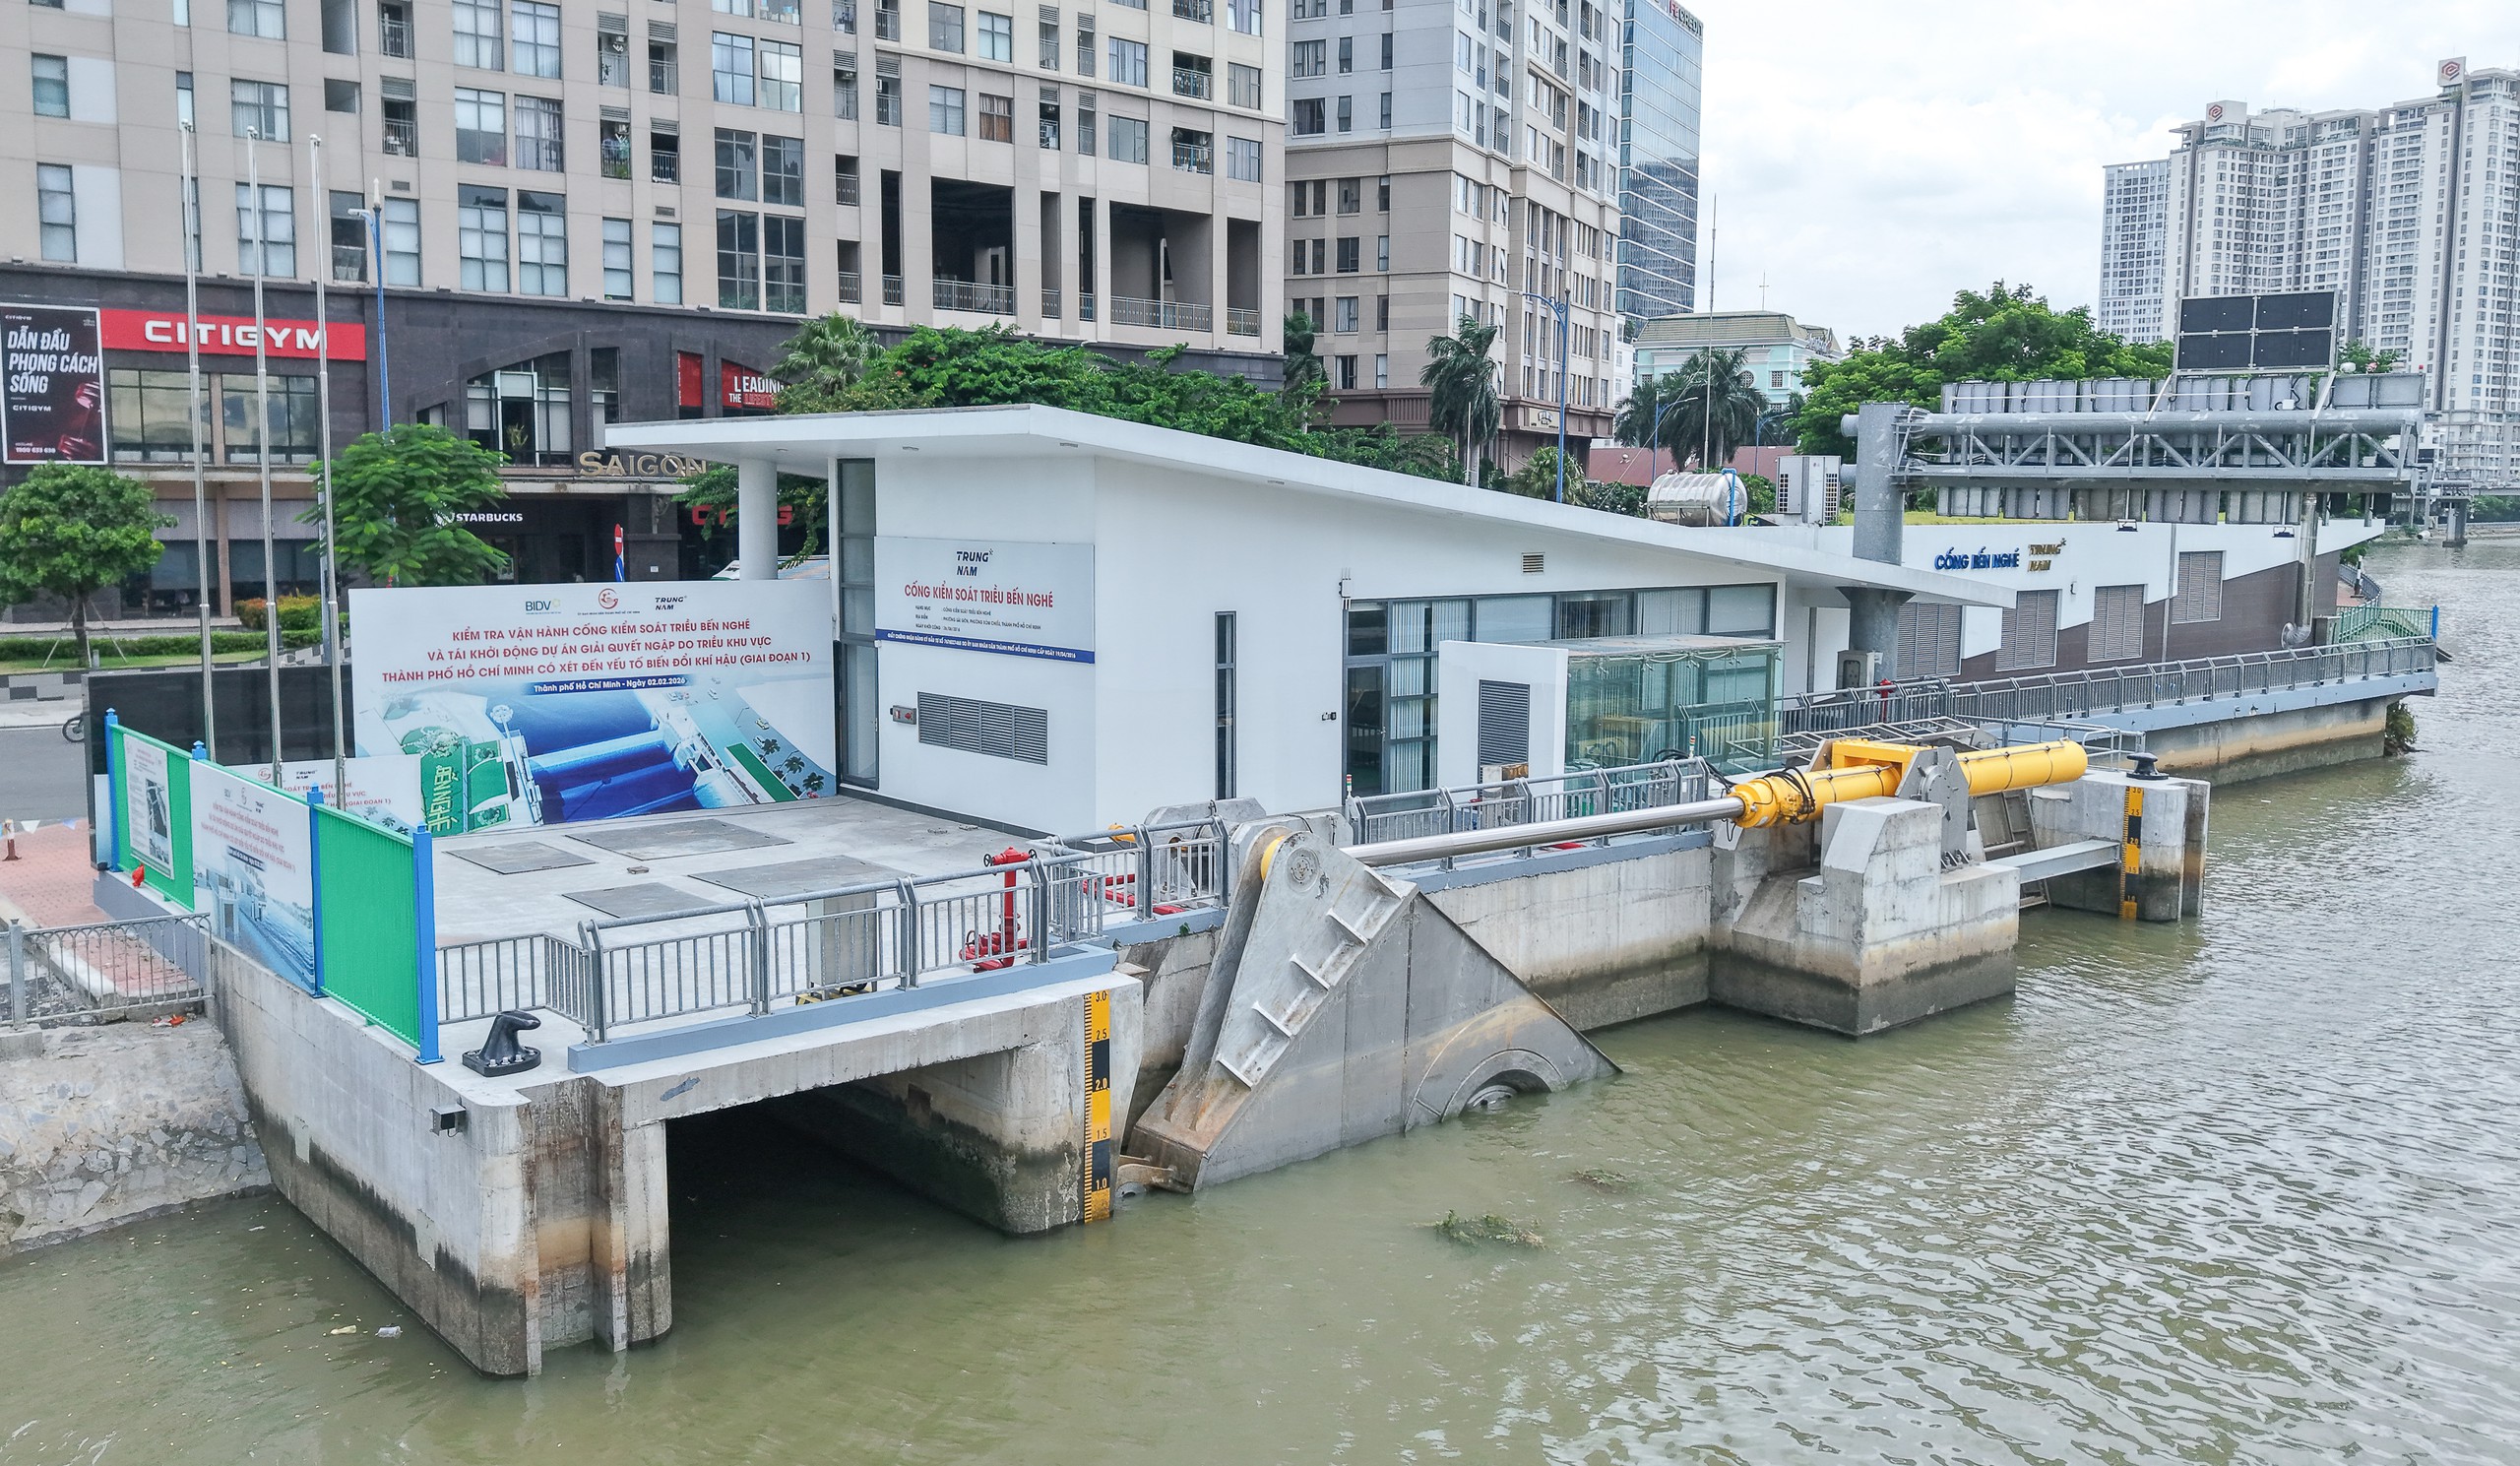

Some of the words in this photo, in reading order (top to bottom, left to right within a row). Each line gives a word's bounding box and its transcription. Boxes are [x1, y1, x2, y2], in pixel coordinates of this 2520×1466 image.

[145, 320, 328, 351] CITIGYM
[9, 352, 57, 372] PHONG
[60, 351, 97, 374] CÁCH
[10, 370, 49, 394] SỐNG
[728, 393, 741, 403] THE
[579, 451, 707, 477] SAIGON
[456, 513, 524, 522] STARBUCKS
[956, 550, 989, 562] TRUNG
[1934, 546, 1970, 570] CỐNG
[1970, 546, 1990, 569] BẾN
[1991, 547, 2019, 568] NGHÉ
[956, 565, 977, 577] NAM
[905, 580, 930, 598] CỐNG
[933, 580, 953, 600] KIỂM
[955, 586, 977, 603] SOÁT
[980, 585, 1004, 604] TRIỀU
[1006, 587, 1024, 606] BẾN
[1027, 591, 1053, 607] NGHÉ
[525, 601, 552, 611] BIDV
[452, 626, 480, 641] KIỂM
[483, 630, 504, 640] TRA
[508, 626, 533, 641] VẬN
[536, 625, 569, 637] HÀNH
[573, 622, 607, 636] CỐNG
[611, 620, 637, 634] KIỂM
[640, 619, 667, 633] SOÁT
[670, 618, 697, 632] TRIỀU
[701, 618, 719, 631] BẾN
[723, 618, 750, 630] NGHÉ
[427, 649, 444, 661] VÀ
[448, 648, 466, 660] TÁI
[470, 646, 499, 659] KHỞI
[503, 645, 537, 660] ĐỘNG
[542, 644, 558, 658] DỰ
[561, 642, 577, 655] ÁN
[581, 641, 603, 654] GIẢI
[607, 638, 641, 653] QUYẾT
[645, 639, 674, 653] NGẬP
[678, 640, 694, 649] DO
[697, 635, 723, 648] TRIỀU
[726, 636, 747, 648] KHU
[750, 636, 772, 649] VỰC
[382, 669, 423, 682] THÀNH
[427, 666, 453, 680] PHỐ
[458, 664, 474, 678] HỒ
[478, 665, 500, 676] CHÍ
[504, 666, 534, 675] MINH
[537, 662, 555, 673] CÓ
[559, 661, 578, 672] XÉT
[582, 659, 602, 671] ĐẾN
[606, 658, 626, 669] YẾU
[629, 656, 643, 669] TỐ
[647, 655, 668, 668] BIẾN
[672, 653, 692, 667] ĐỔI
[695, 655, 713, 666] KHÍ
[716, 653, 736, 667] HẬU
[740, 654, 766, 667] (GIAI
[769, 653, 797, 664] ĐOẠN
[801, 652, 811, 663] 1)
[559, 681, 574, 692] phố
[589, 680, 601, 689] Chí
[602, 679, 620, 688] Minh
[626, 678, 646, 689] Ngày
[648, 677, 685, 686] 02.02.2026
[1096, 990, 1107, 1002] 3.0
[1097, 1028, 1106, 1040] 2.5
[1096, 1078, 1107, 1090] 2.0
[1097, 1128, 1106, 1140] 1.5
[1096, 1178, 1106, 1190] 1.0
